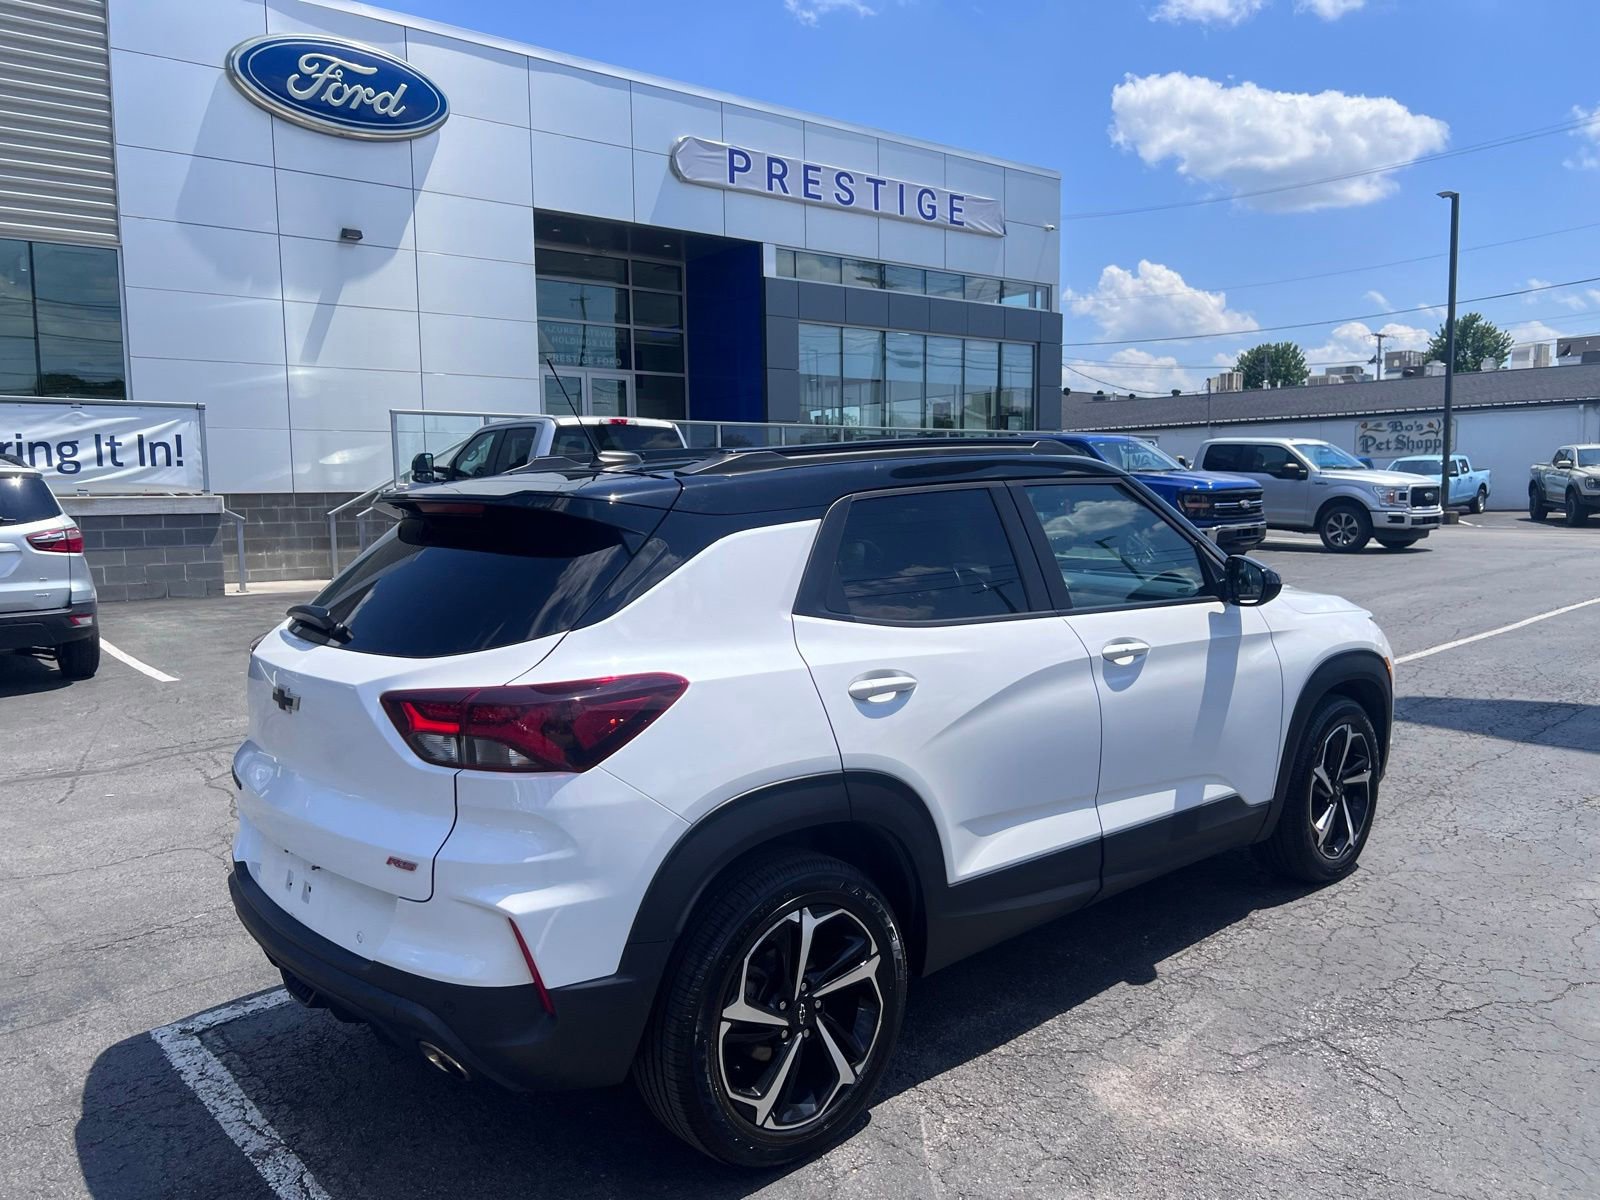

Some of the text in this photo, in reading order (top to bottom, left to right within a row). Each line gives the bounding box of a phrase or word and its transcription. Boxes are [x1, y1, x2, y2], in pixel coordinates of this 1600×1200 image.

[286, 53, 408, 117] Ford
[727, 147, 966, 226] PRESTIGE
[577, 327, 616, 338] GATEWA
[545, 352, 622, 367] PRESTIGE FORD
[1387, 420, 1424, 434] Bo's
[0, 433, 184, 474] ring It In!
[1359, 433, 1442, 455] Pet Shopp
